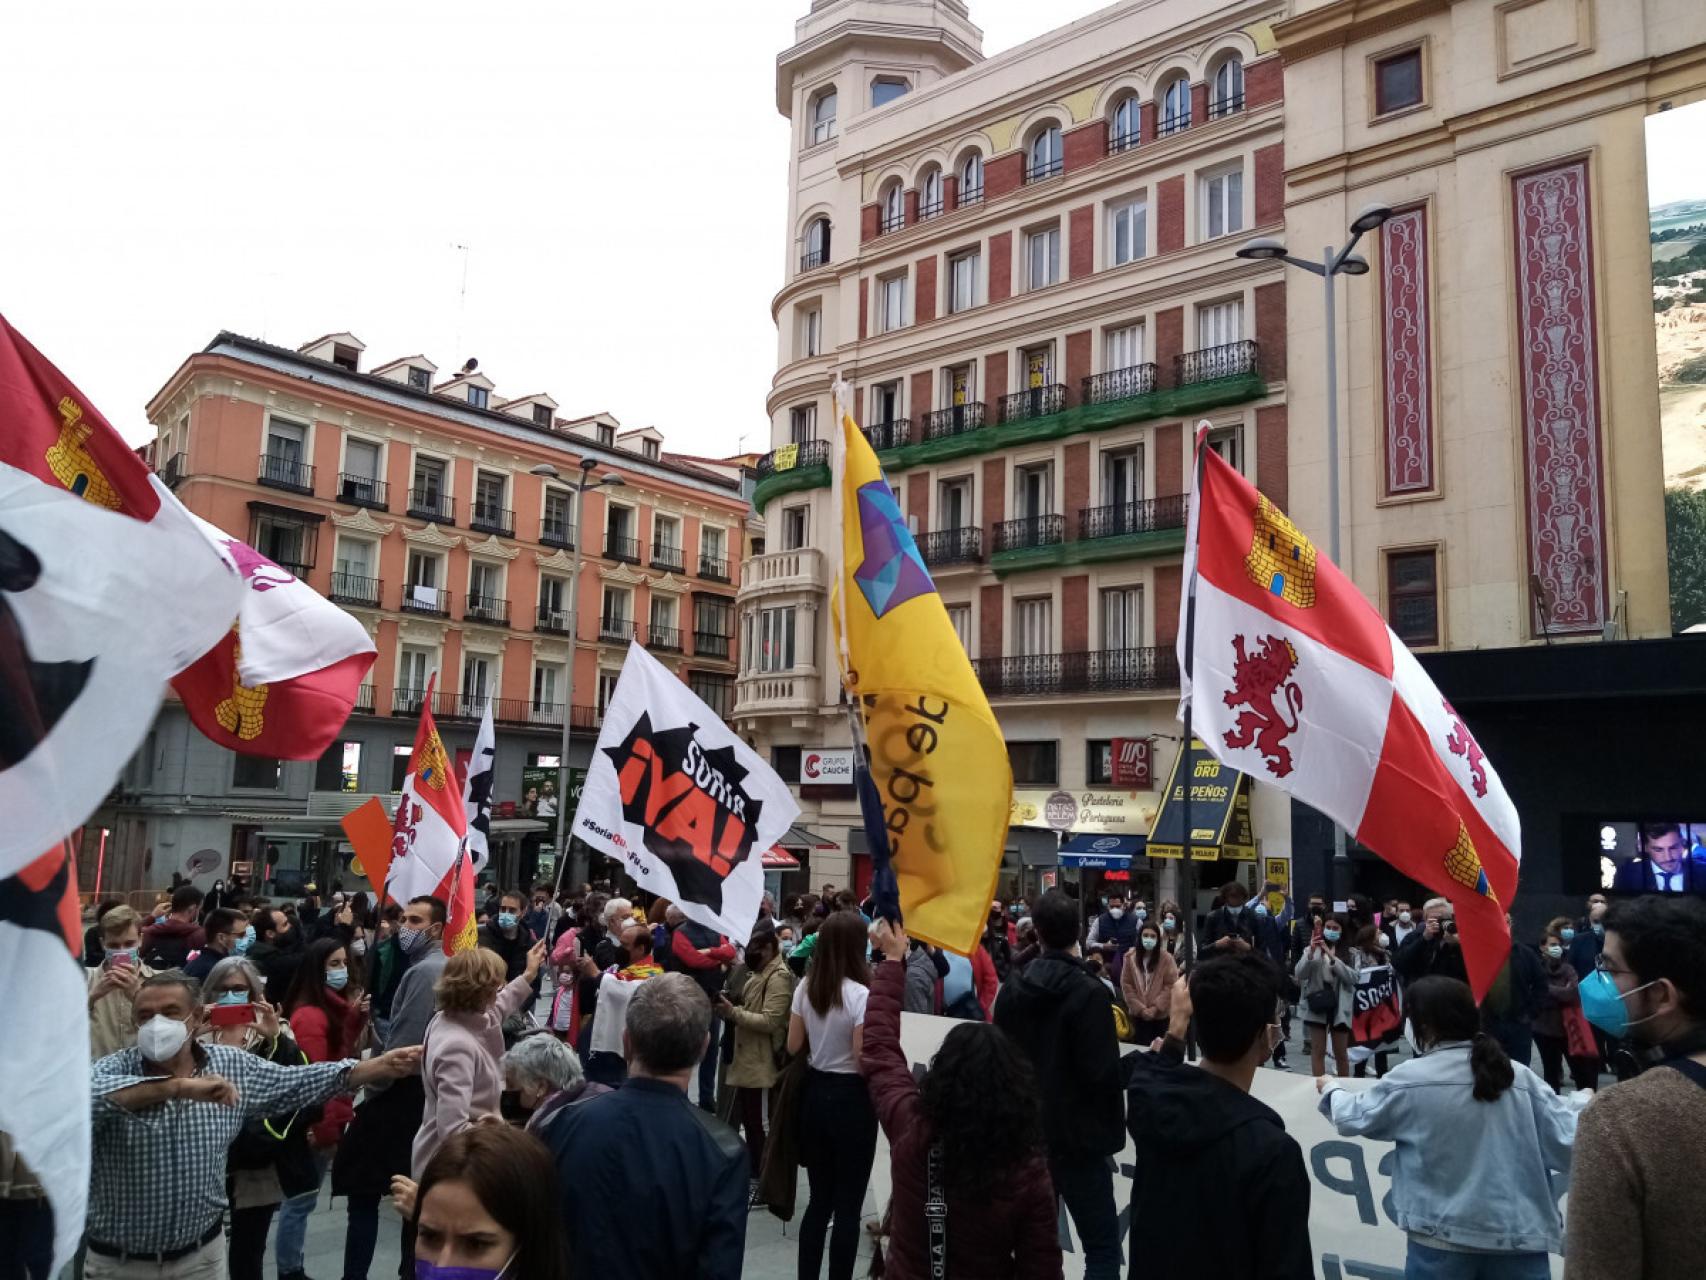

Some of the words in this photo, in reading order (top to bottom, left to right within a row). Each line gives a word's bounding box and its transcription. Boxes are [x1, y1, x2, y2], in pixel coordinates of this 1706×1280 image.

[822, 757, 847, 766] GRUPO
[822, 766, 850, 775] CAUCHE
[1193, 765, 1220, 778] ORO
[1174, 784, 1229, 798] EPEÑOS
[933, 1243, 945, 1280] OLA
